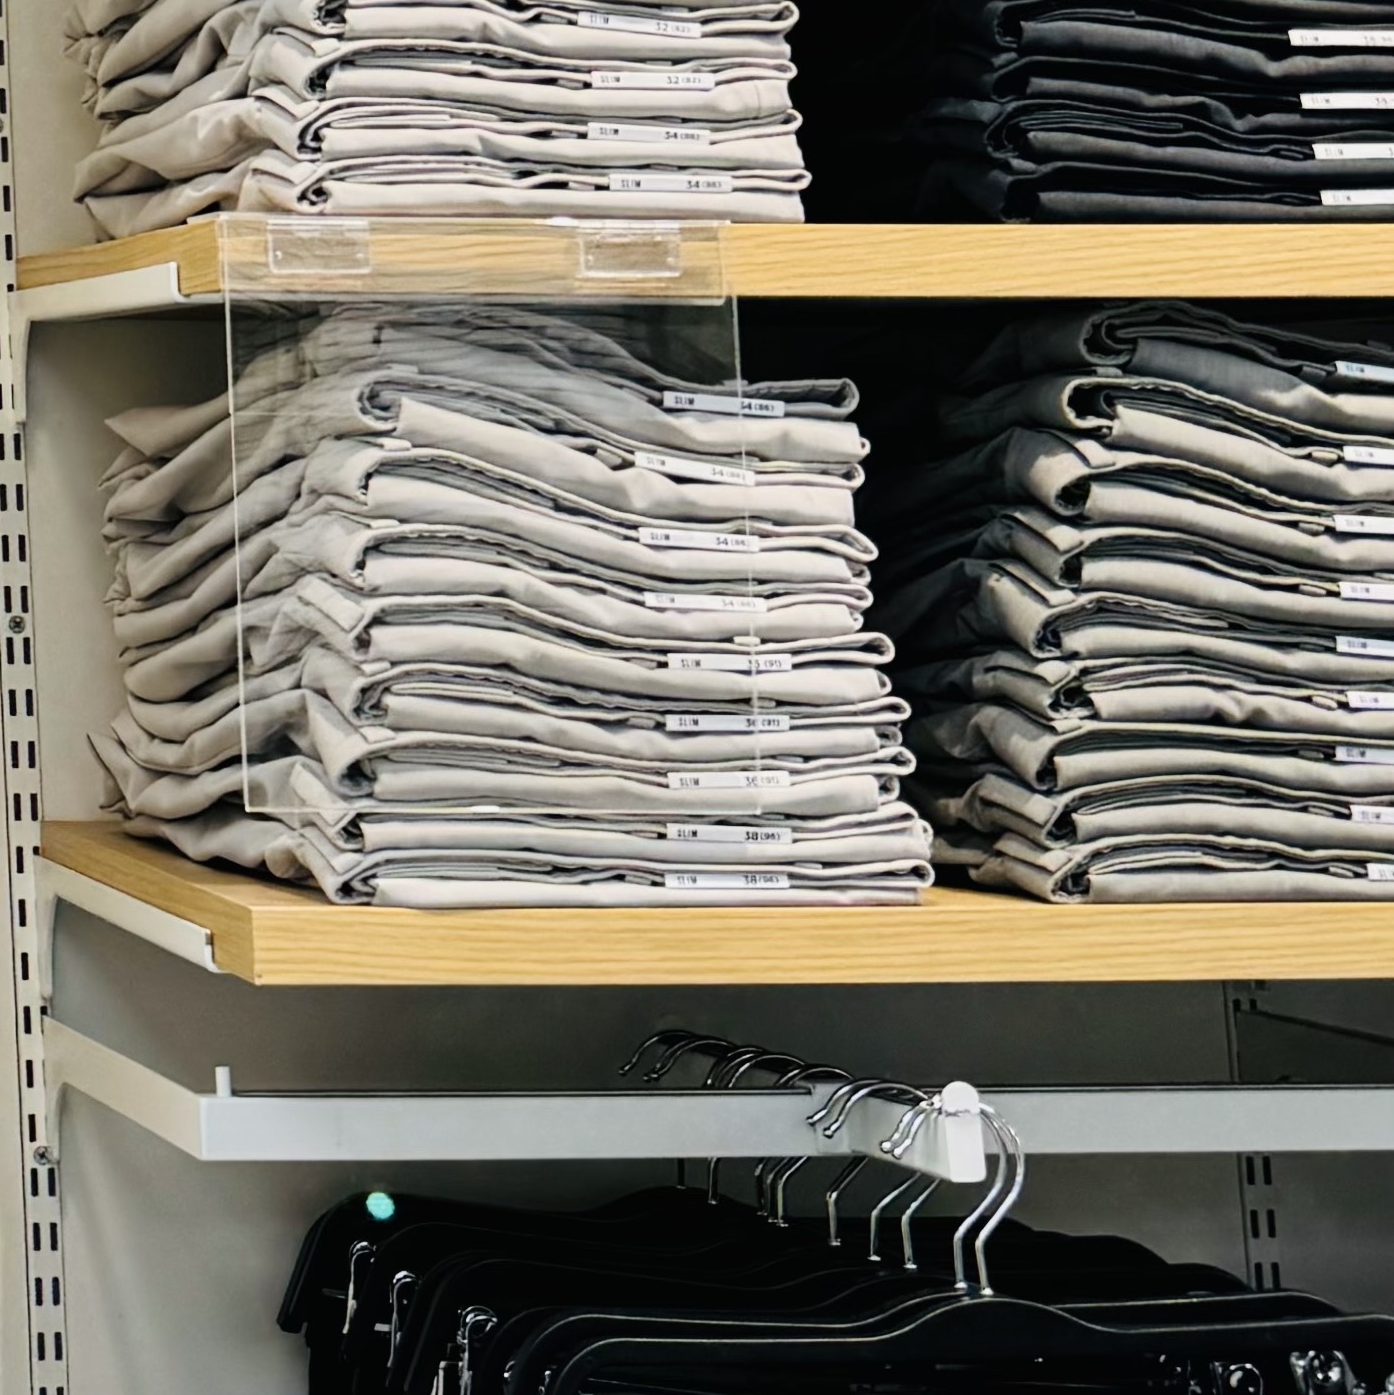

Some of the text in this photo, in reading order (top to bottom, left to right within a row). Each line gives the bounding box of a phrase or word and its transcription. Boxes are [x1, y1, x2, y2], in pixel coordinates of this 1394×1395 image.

[674, 395, 695, 406] SLIM
[681, 658, 701, 668] SLIM
[678, 717, 699, 727] SLIM
[679, 777, 700, 787] SLIM
[677, 829, 698, 838] SLIM
